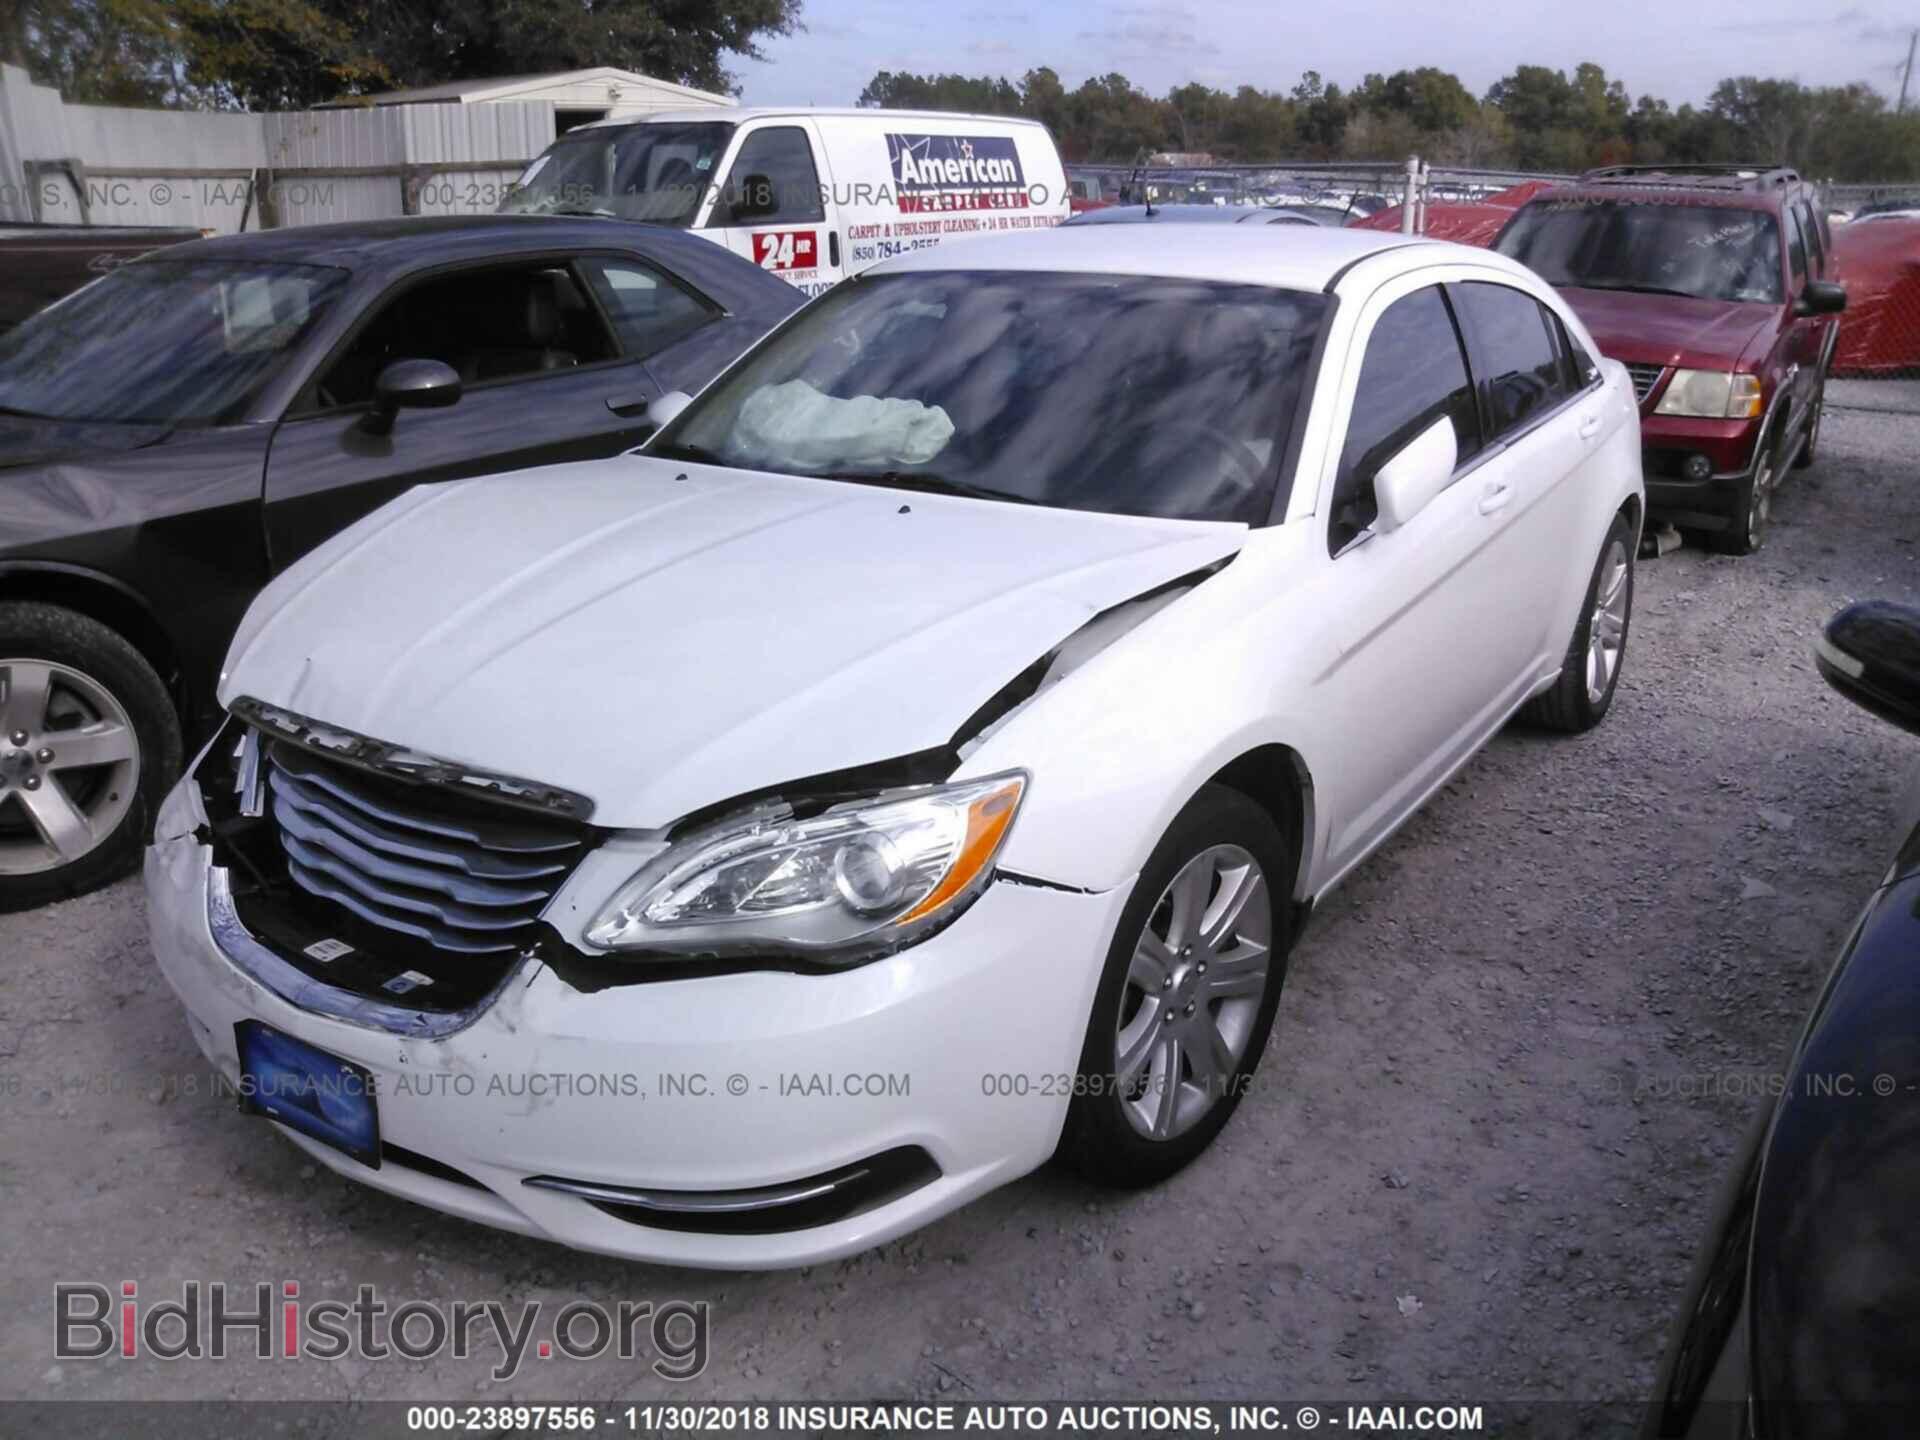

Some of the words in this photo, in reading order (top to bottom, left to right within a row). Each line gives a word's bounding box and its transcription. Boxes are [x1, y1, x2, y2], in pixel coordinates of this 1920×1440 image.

[901, 147, 1018, 185] American
[848, 225, 880, 239] CARPET
[761, 233, 795, 269] 24
[796, 239, 811, 253] HR
